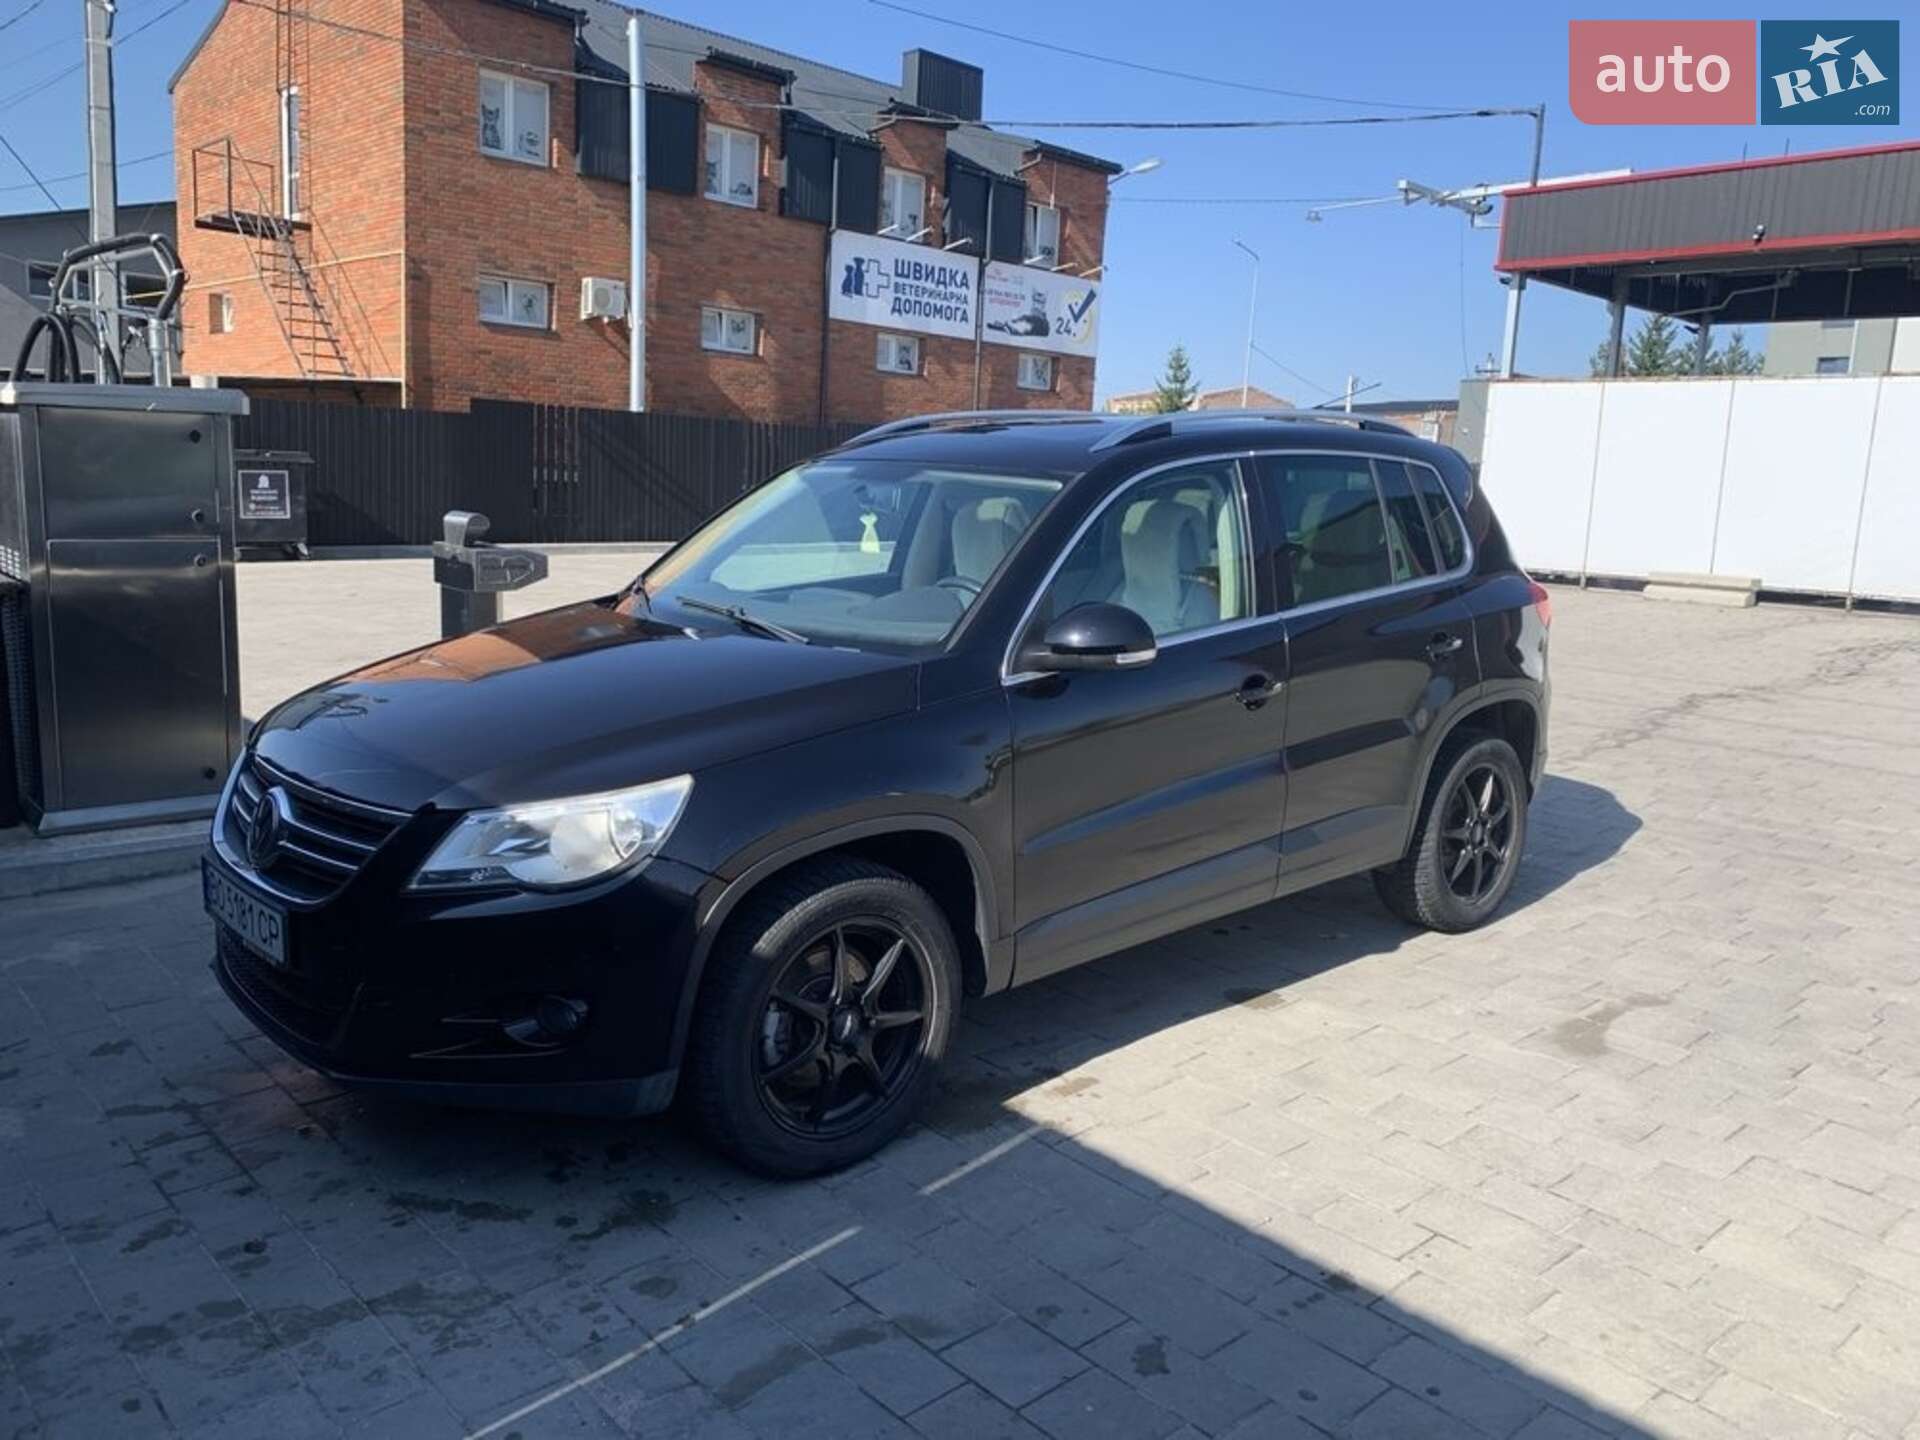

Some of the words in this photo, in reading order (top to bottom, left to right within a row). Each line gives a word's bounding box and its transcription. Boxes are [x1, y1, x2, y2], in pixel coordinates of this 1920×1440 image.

[894, 258, 969, 290] ШВИДКА
[894, 281, 968, 305] ВЕТЕРИНАРНА
[890, 296, 969, 323] ДОПОМОГА
